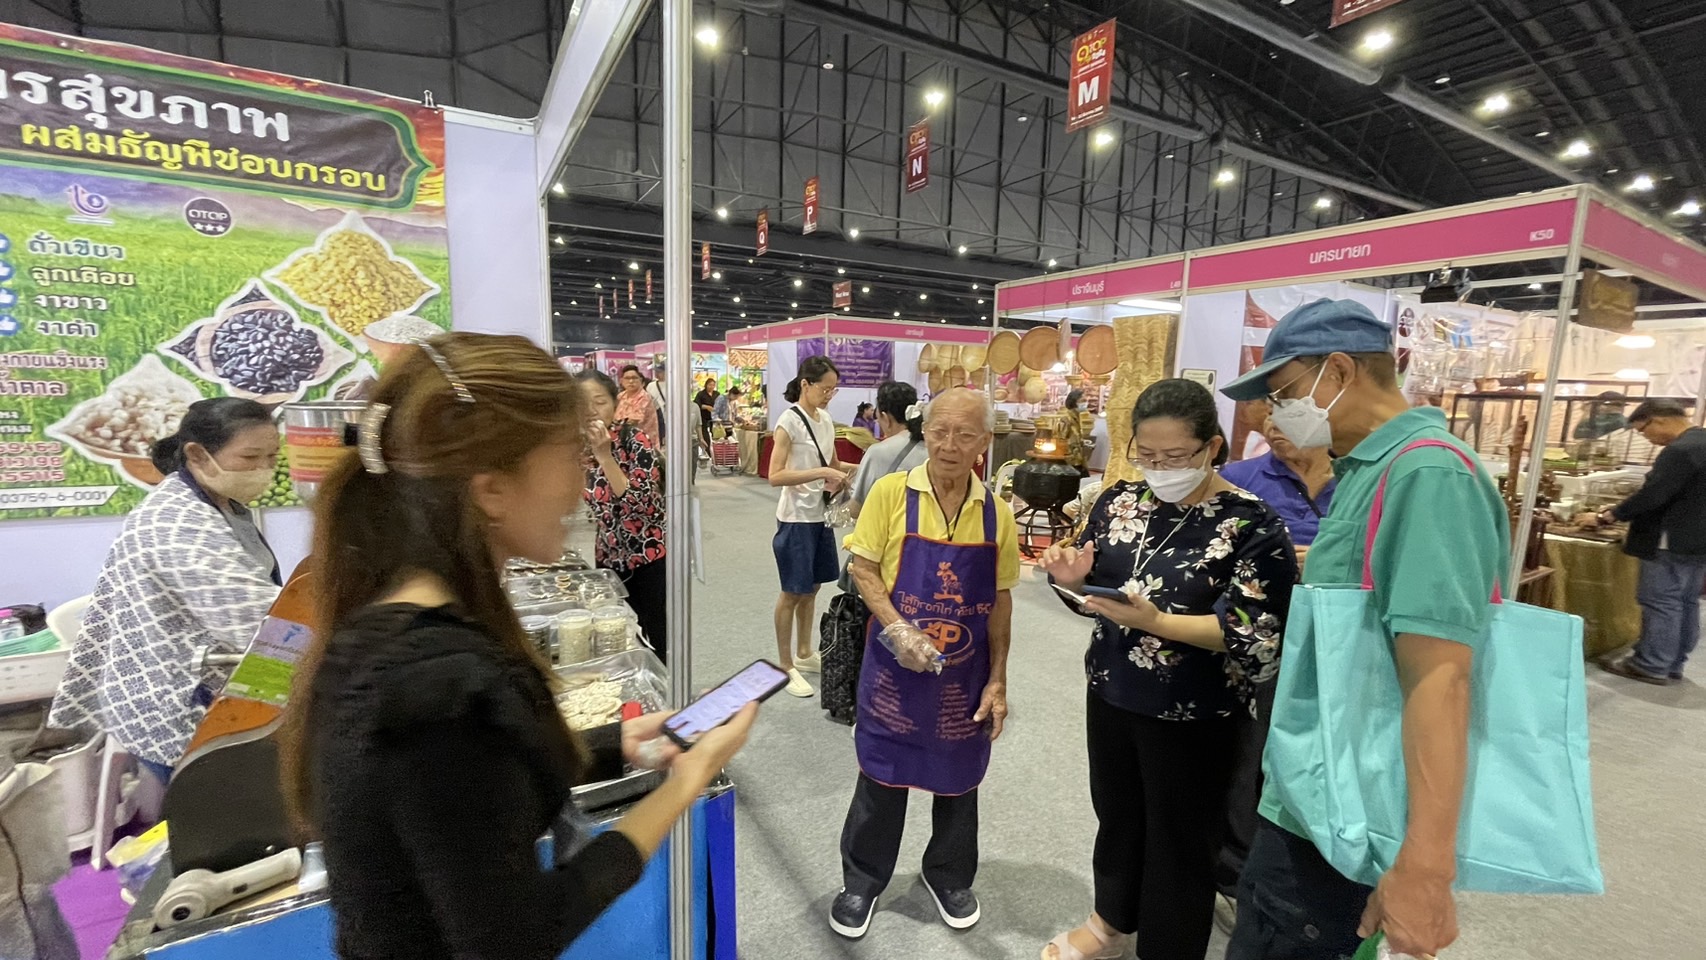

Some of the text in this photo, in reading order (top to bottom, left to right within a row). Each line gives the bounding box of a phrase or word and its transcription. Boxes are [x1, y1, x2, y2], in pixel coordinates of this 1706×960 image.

[1078, 75, 1100, 107] M
[21, 123, 387, 193] ผสมธัญพืชอบกรอบ
[912, 155, 923, 177] N
[188, 209, 228, 221] OTOP
[806, 205, 814, 225] P
[28, 232, 125, 259] ถั่วเขียว
[1309, 243, 1372, 265] นครนายก
[32, 266, 136, 287] ลูกเดือย
[35, 294, 108, 311] งาขาว
[37, 318, 98, 337] งาดำ
[899, 602, 918, 616] TOP
